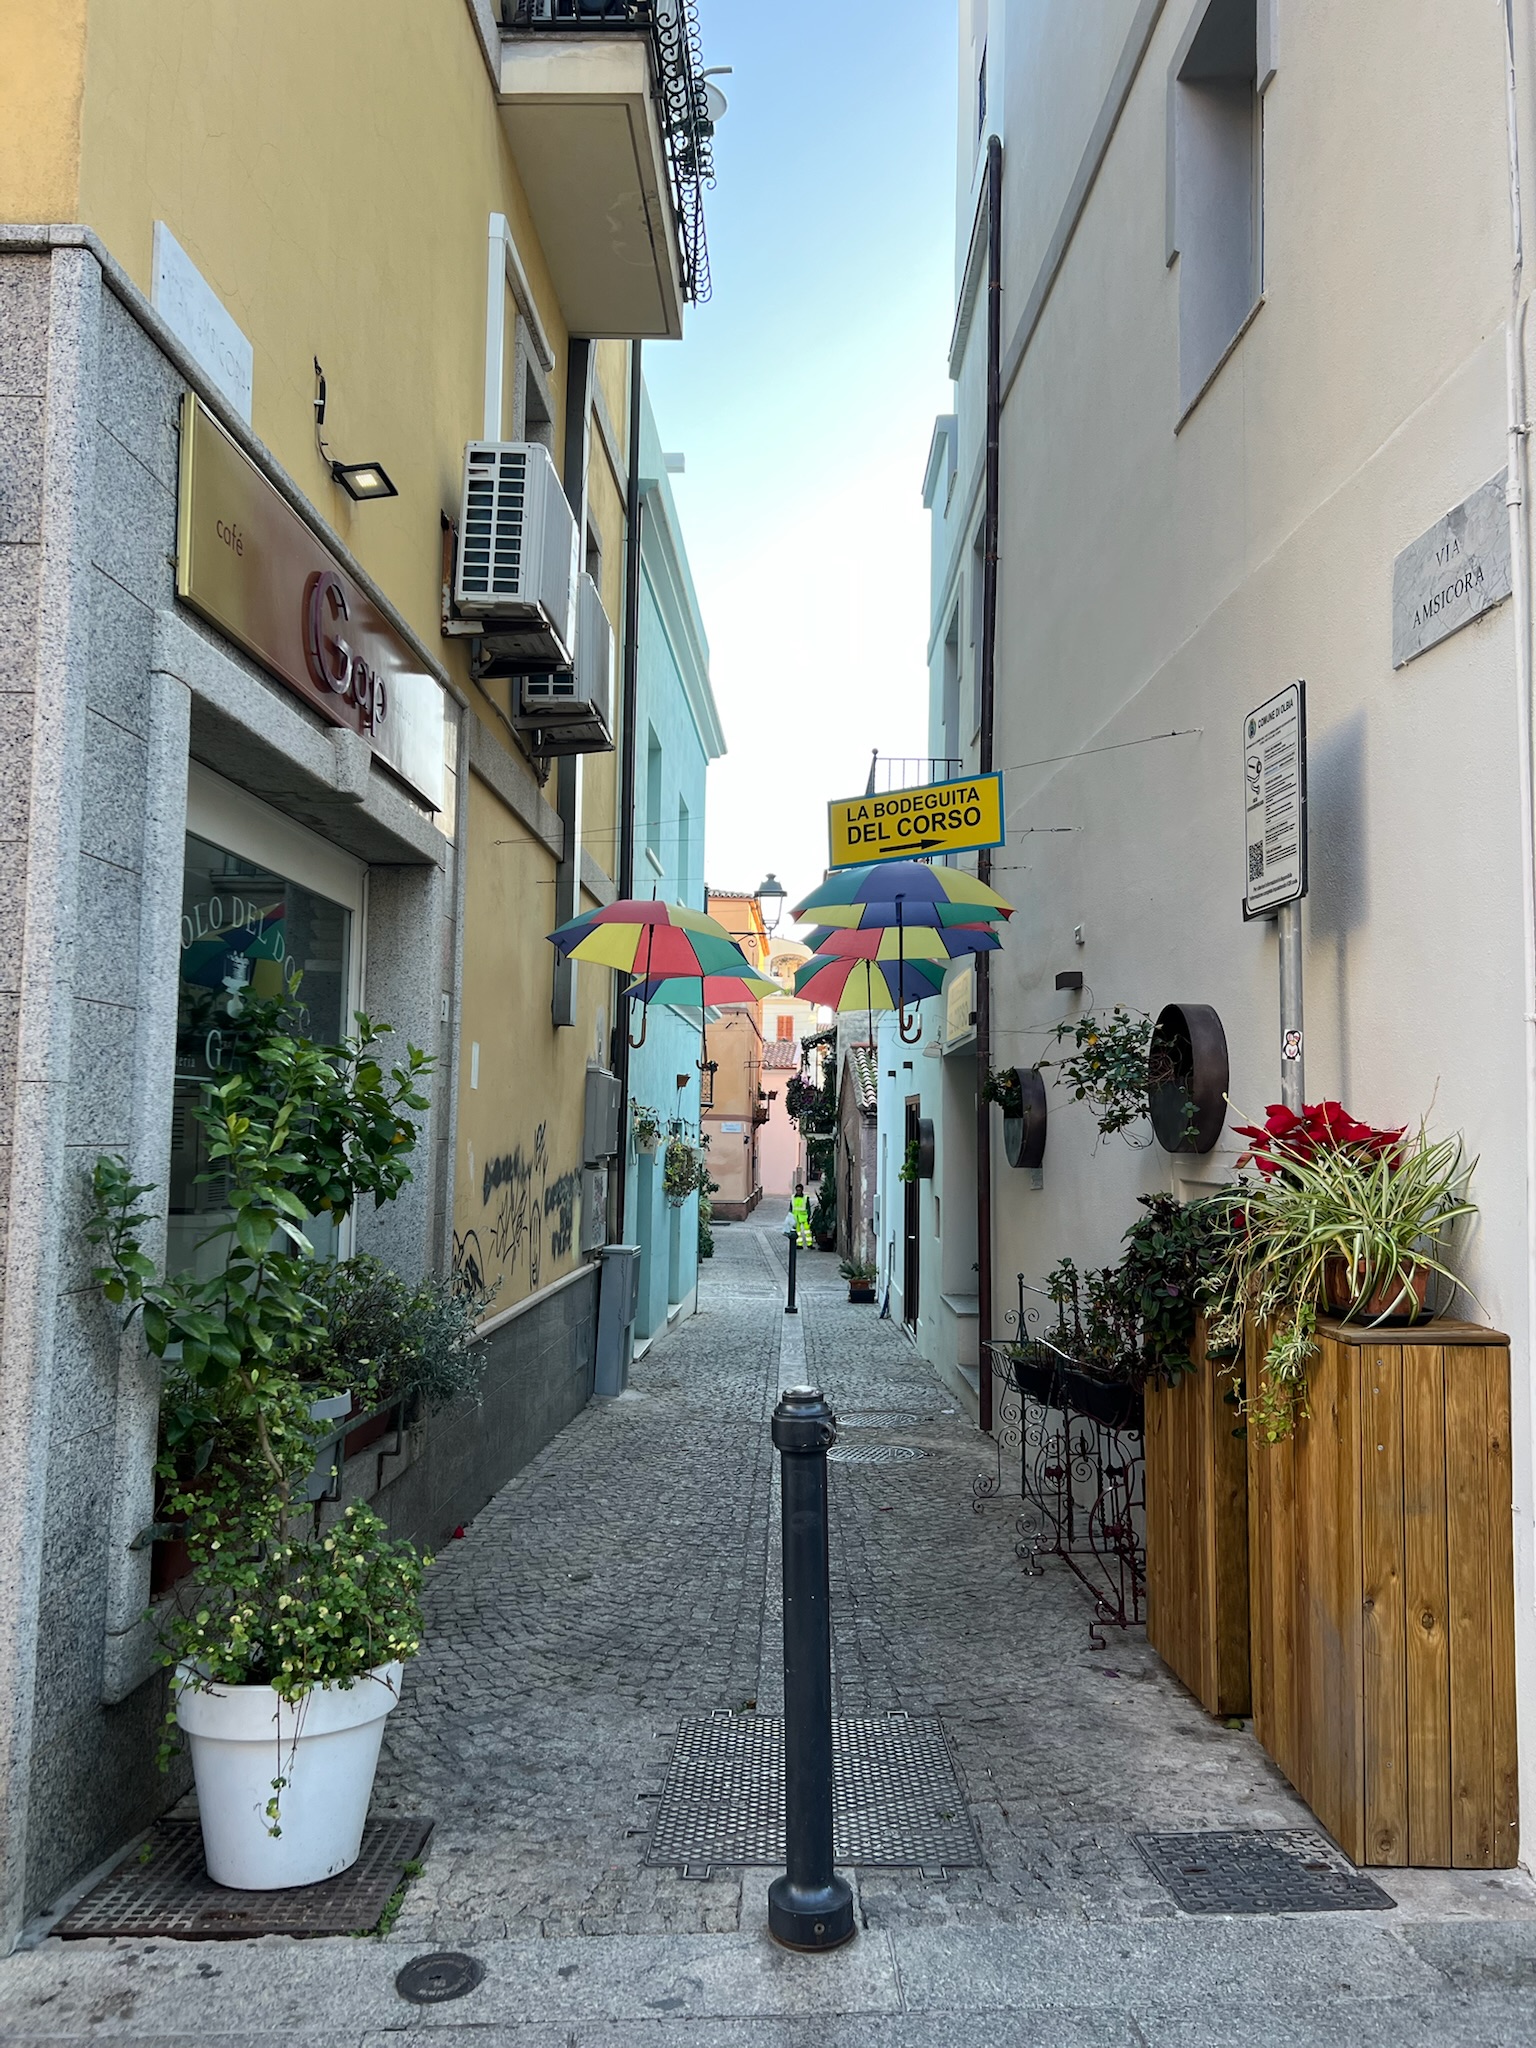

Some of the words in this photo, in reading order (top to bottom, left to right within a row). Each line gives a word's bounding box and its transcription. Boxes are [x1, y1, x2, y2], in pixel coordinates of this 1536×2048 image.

[216, 519, 244, 557] café
[1435, 538, 1461, 567] VIA
[1412, 565, 1485, 629] AMSICORA
[1258, 709, 1275, 728] COMUNE
[1280, 698, 1294, 714] OLBIA
[846, 805, 869, 823] LA
[874, 786, 980, 818] BODEGUITA
[847, 821, 891, 845] DEL
[897, 806, 981, 837] CORSO
[232, 896, 268, 945] DEL
